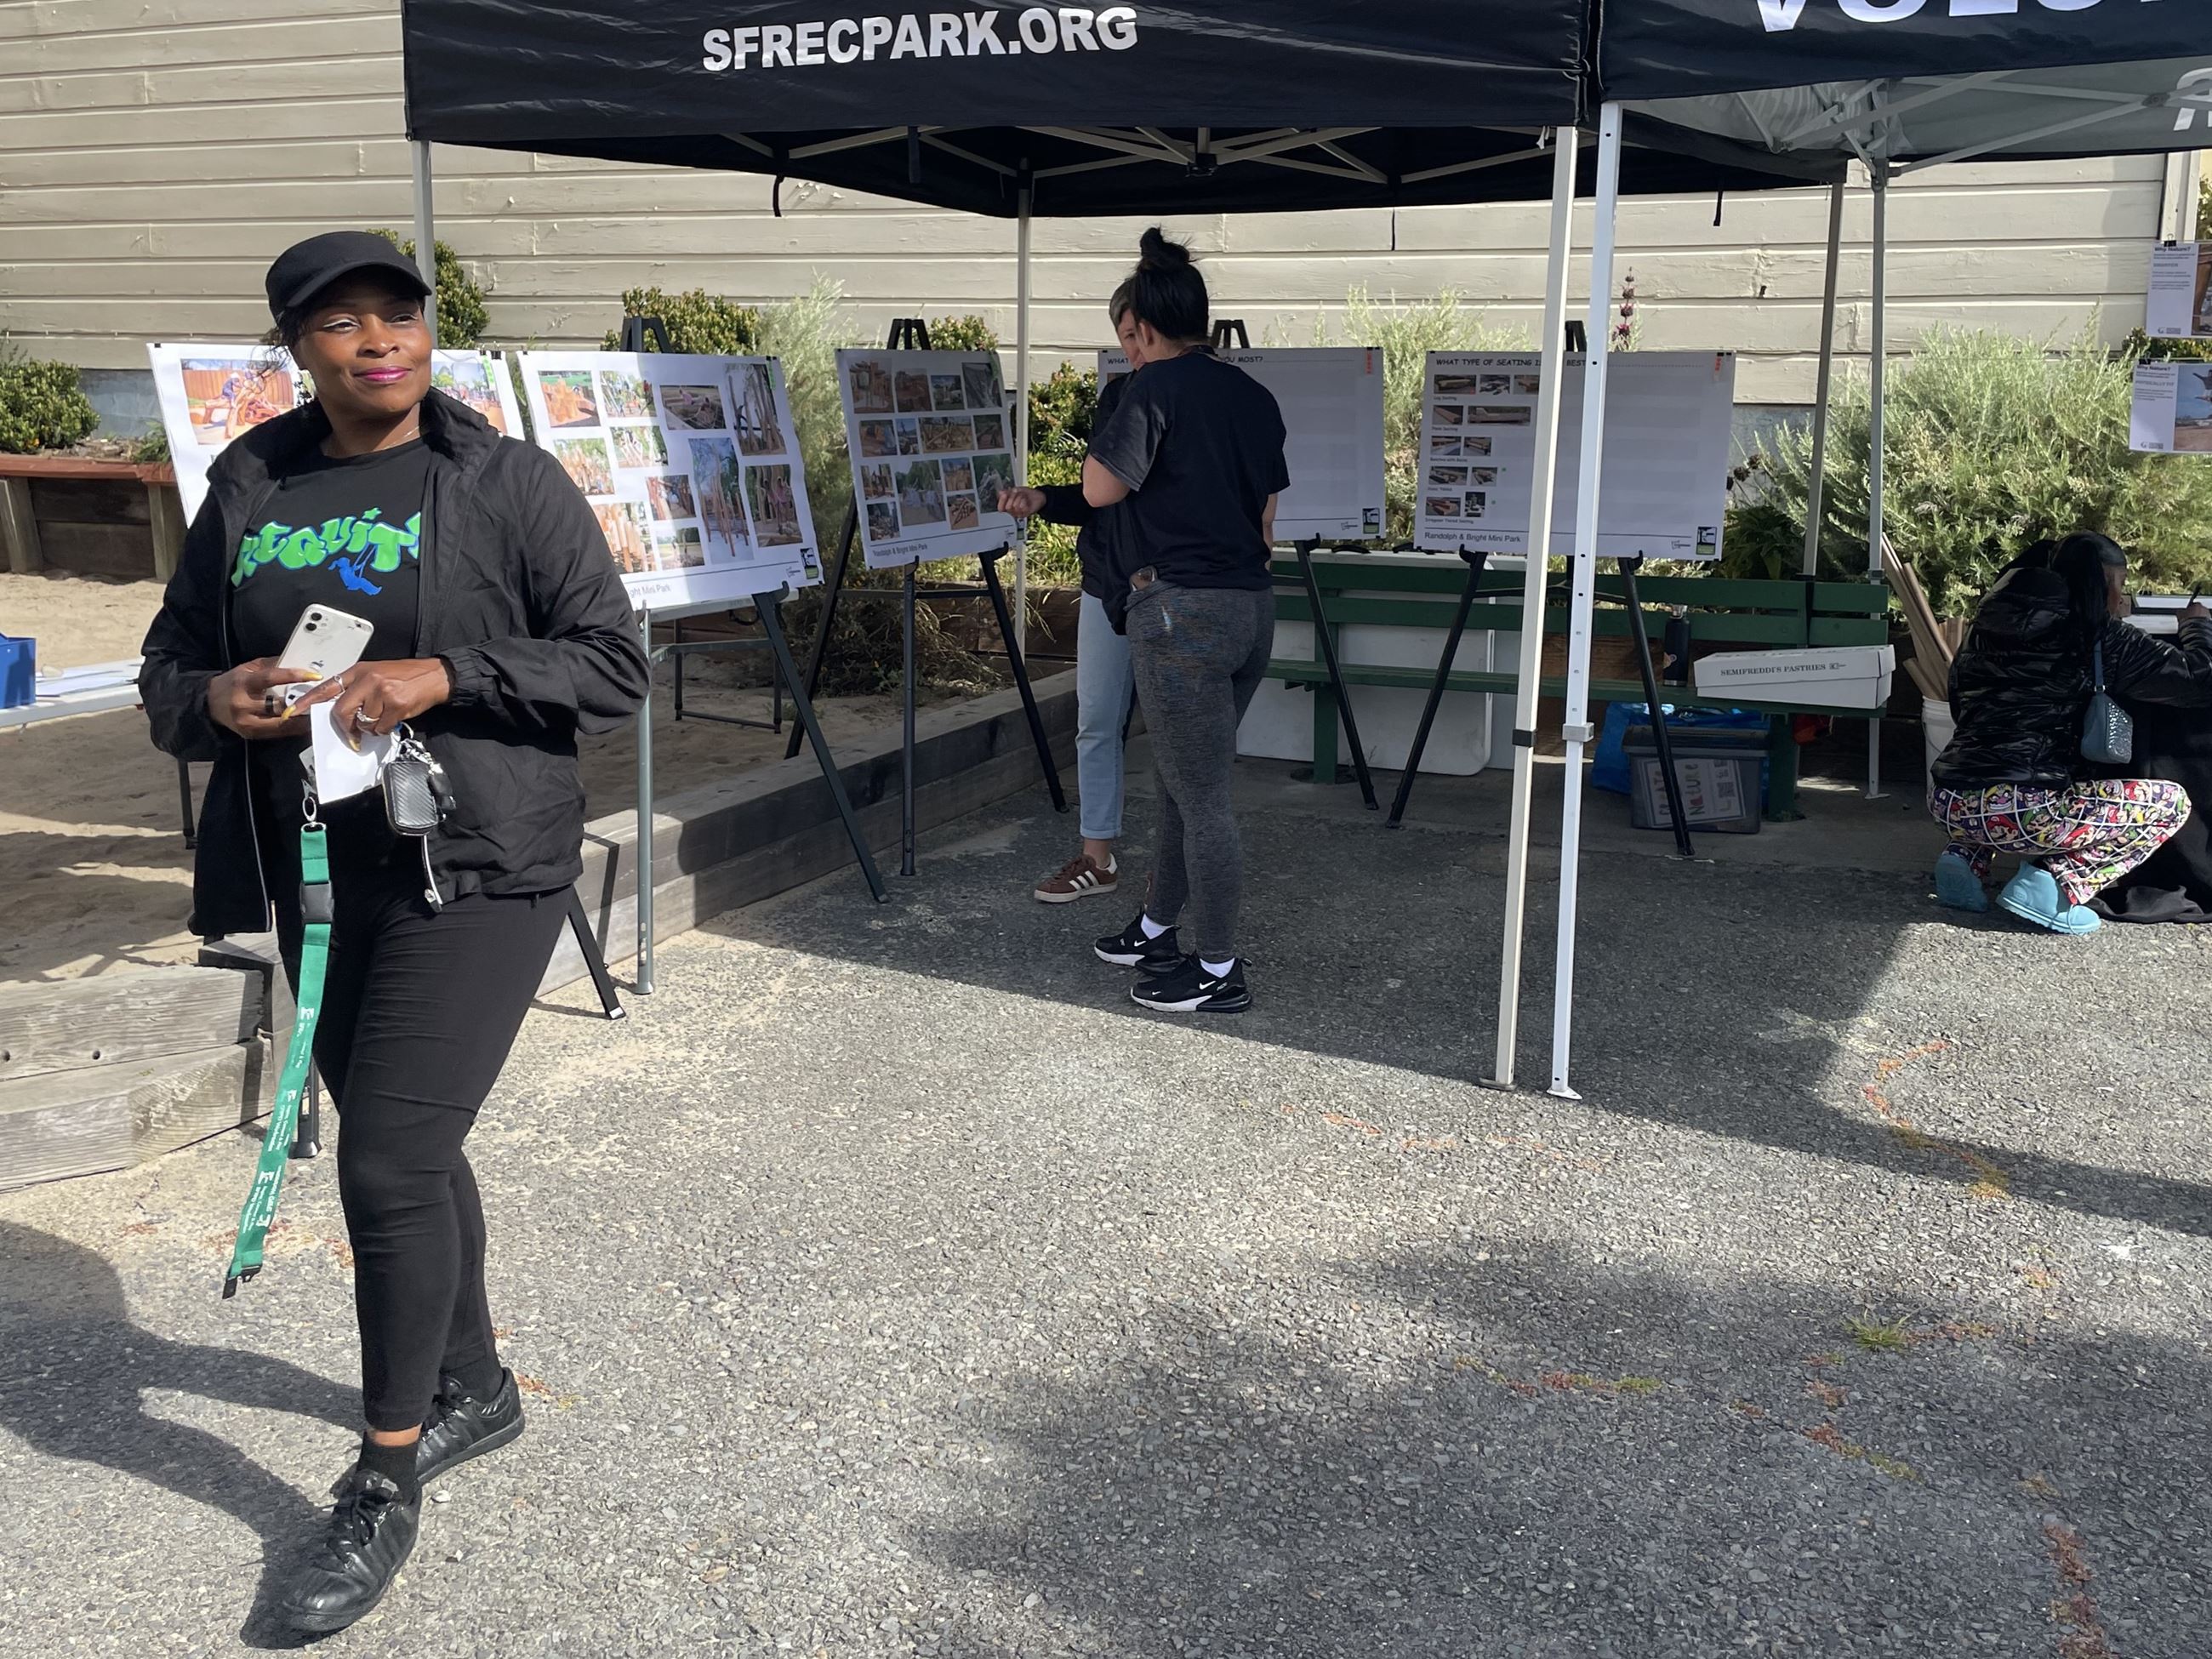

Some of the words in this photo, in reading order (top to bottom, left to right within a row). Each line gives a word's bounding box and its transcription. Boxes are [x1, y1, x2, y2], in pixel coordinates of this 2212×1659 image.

[703, 7, 1137, 71] SFRECPARK.ORG
[1425, 533, 1457, 541] Randolph
[1466, 534, 1486, 543] Bright
[1784, 664, 1826, 674] PASTRIES
